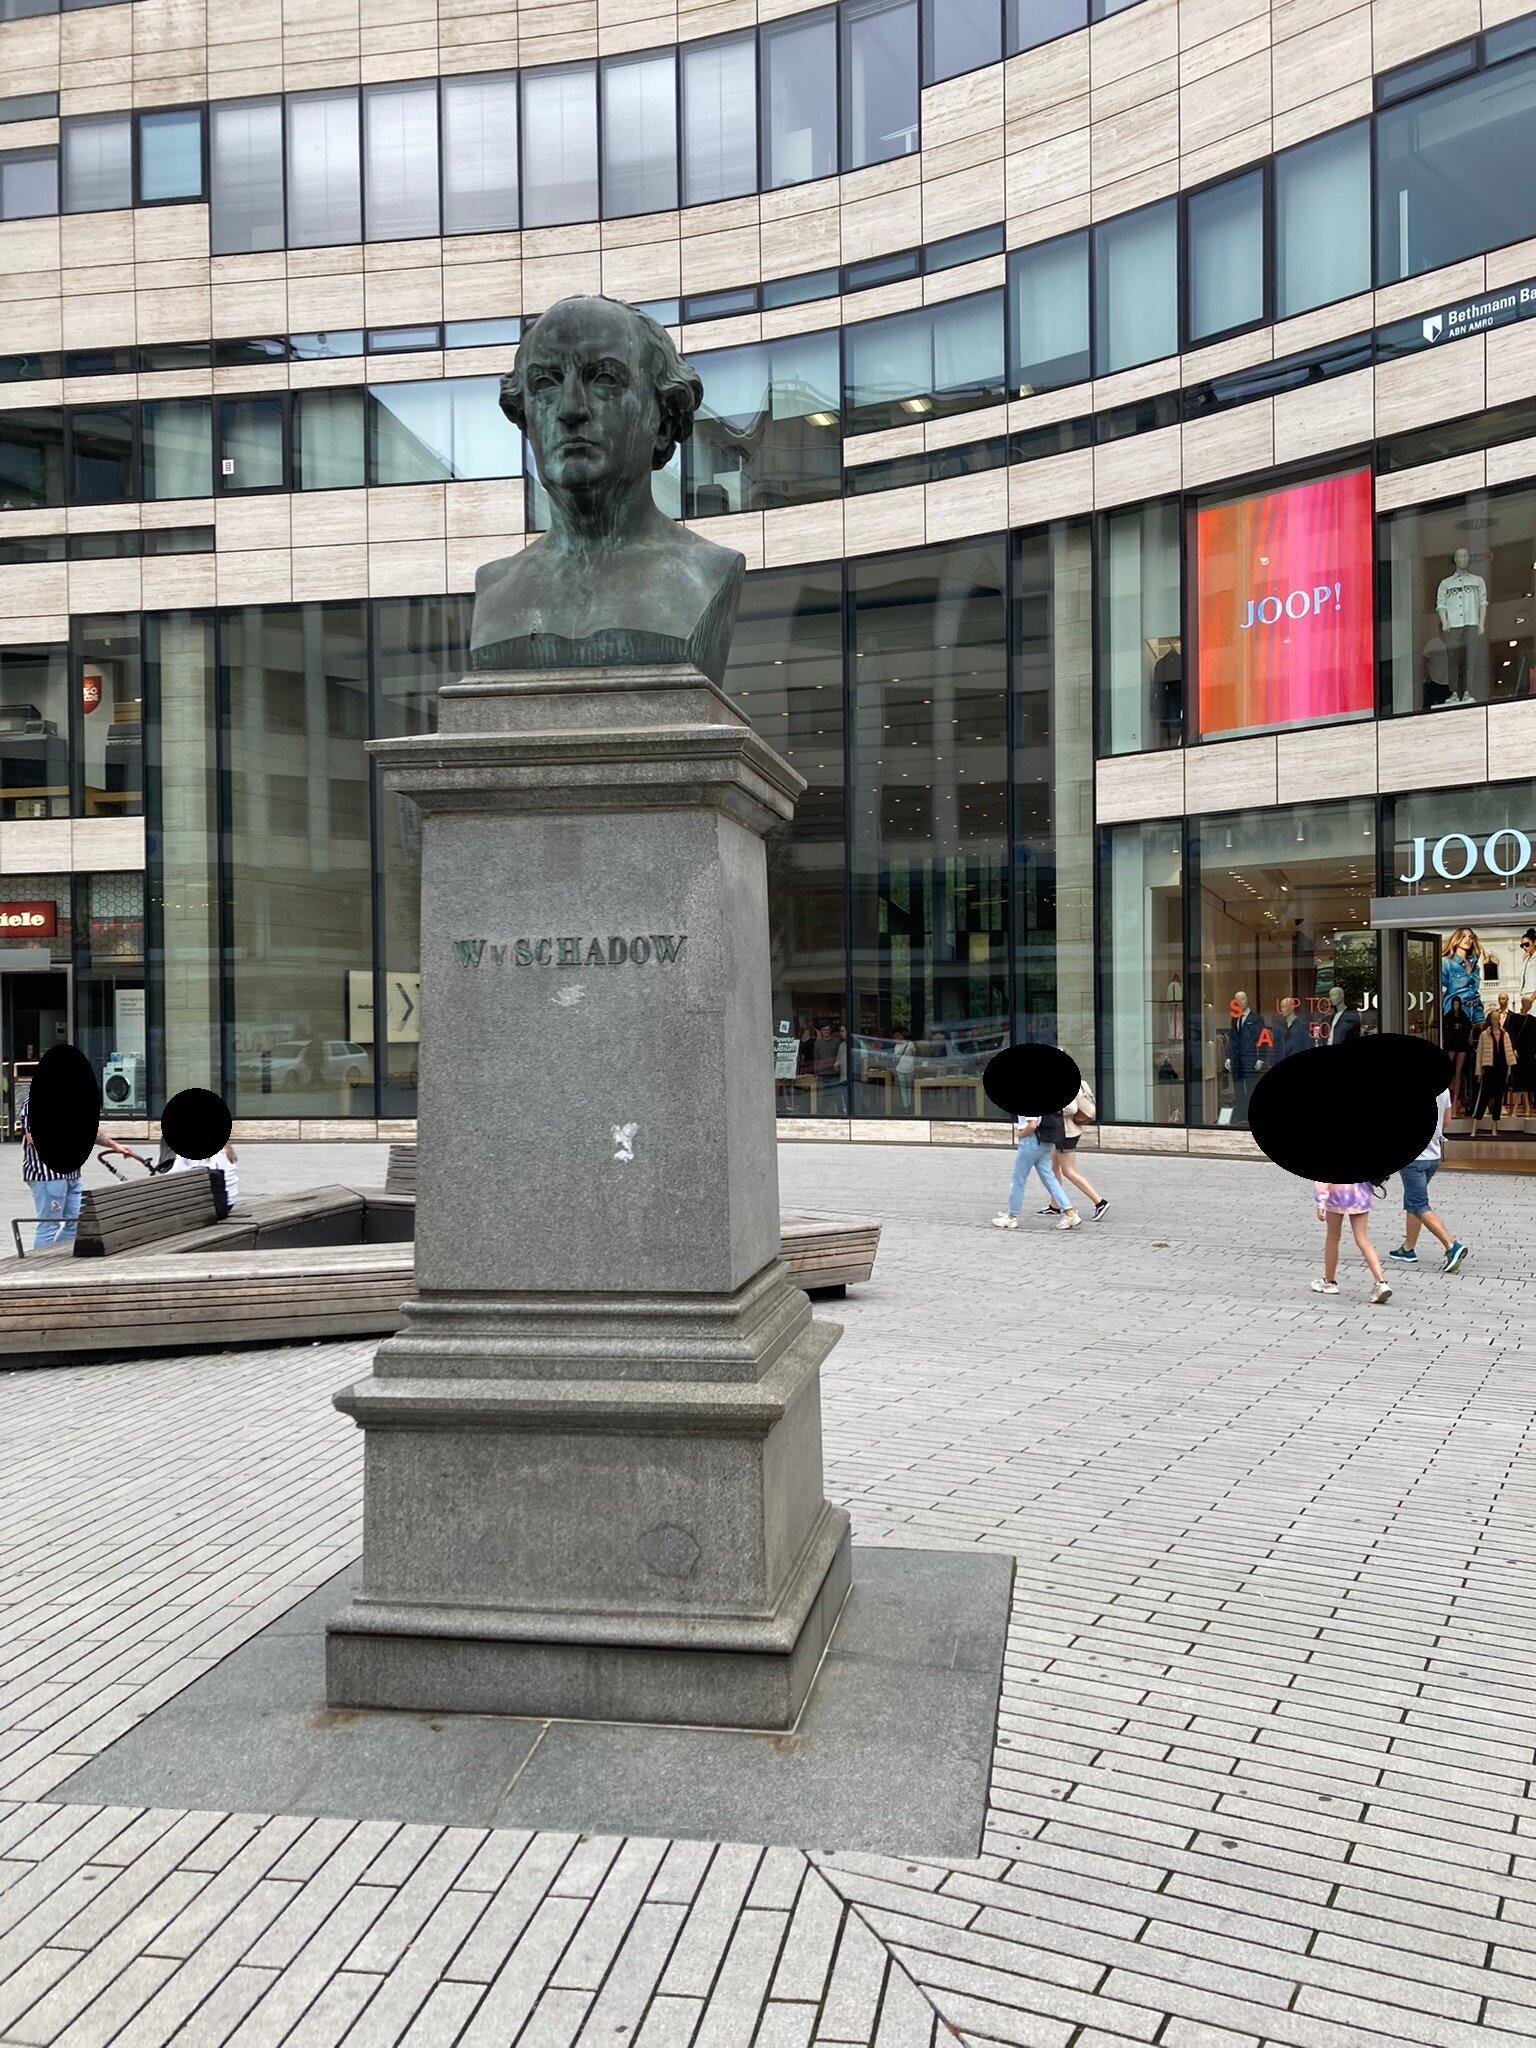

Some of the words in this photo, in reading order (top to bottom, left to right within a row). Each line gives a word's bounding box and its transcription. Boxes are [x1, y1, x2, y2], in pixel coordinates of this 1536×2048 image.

[1448, 295, 1516, 325] Bethmann
[1449, 325, 1467, 338] ABN
[1468, 316, 1494, 332] AMRO
[1240, 582, 1341, 629] JOOP!
[1399, 828, 1532, 883] JOO
[0, 912, 45, 927] iele
[515, 934, 687, 966] SCHADOW
[1276, 997, 1300, 1015] UP
[1305, 997, 1332, 1015] TO
